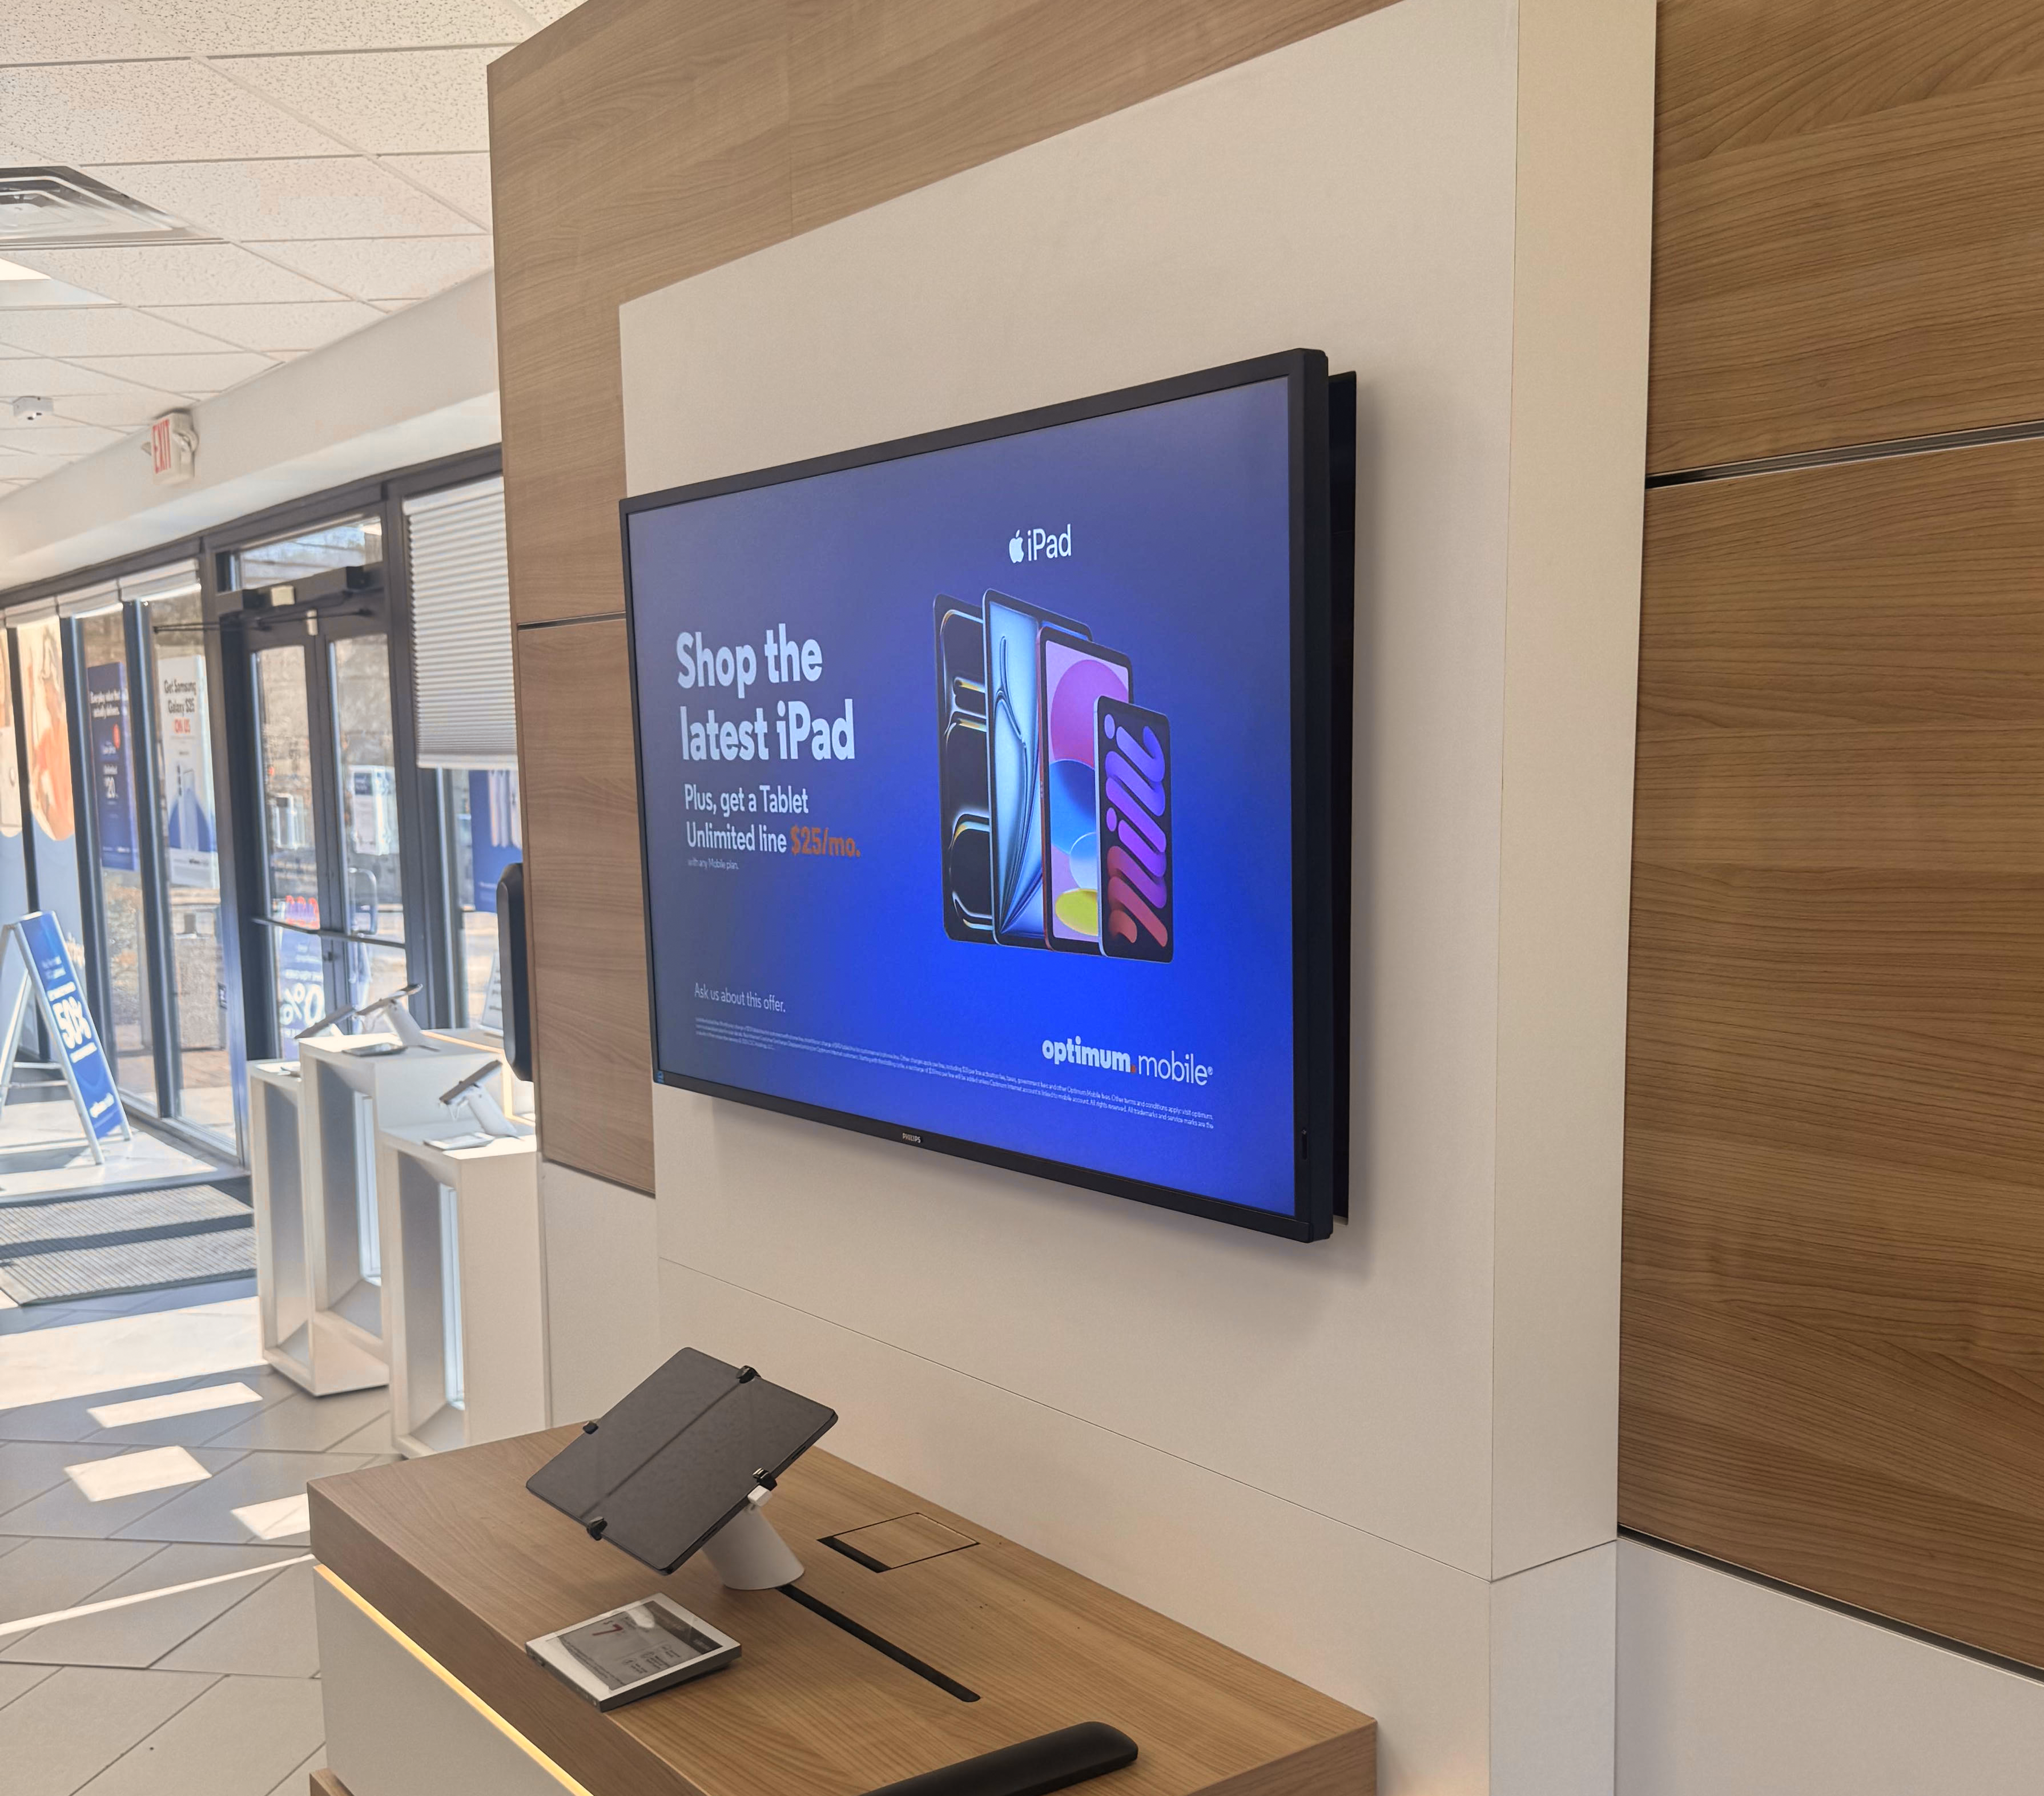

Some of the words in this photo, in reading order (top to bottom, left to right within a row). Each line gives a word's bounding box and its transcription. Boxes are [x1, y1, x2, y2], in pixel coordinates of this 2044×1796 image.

[152, 418, 171, 474] EXIT
[1028, 524, 1072, 561] iPad
[677, 631, 757, 698] Shop
[765, 623, 823, 683] the
[679, 706, 770, 760] latest
[776, 699, 855, 760] iPad
[685, 784, 717, 815] Plus,
[721, 787, 745, 817] get
[749, 792, 757, 812] a
[759, 785, 808, 814] Tablet
[686, 822, 755, 851] Unlimited
[759, 824, 787, 853] line
[790, 824, 861, 857] $25/mo.
[694, 982, 709, 999] Ask
[710, 989, 719, 1001] us
[721, 987, 745, 1006] about
[746, 991, 762, 1008] this
[764, 994, 786, 1012] offer.
